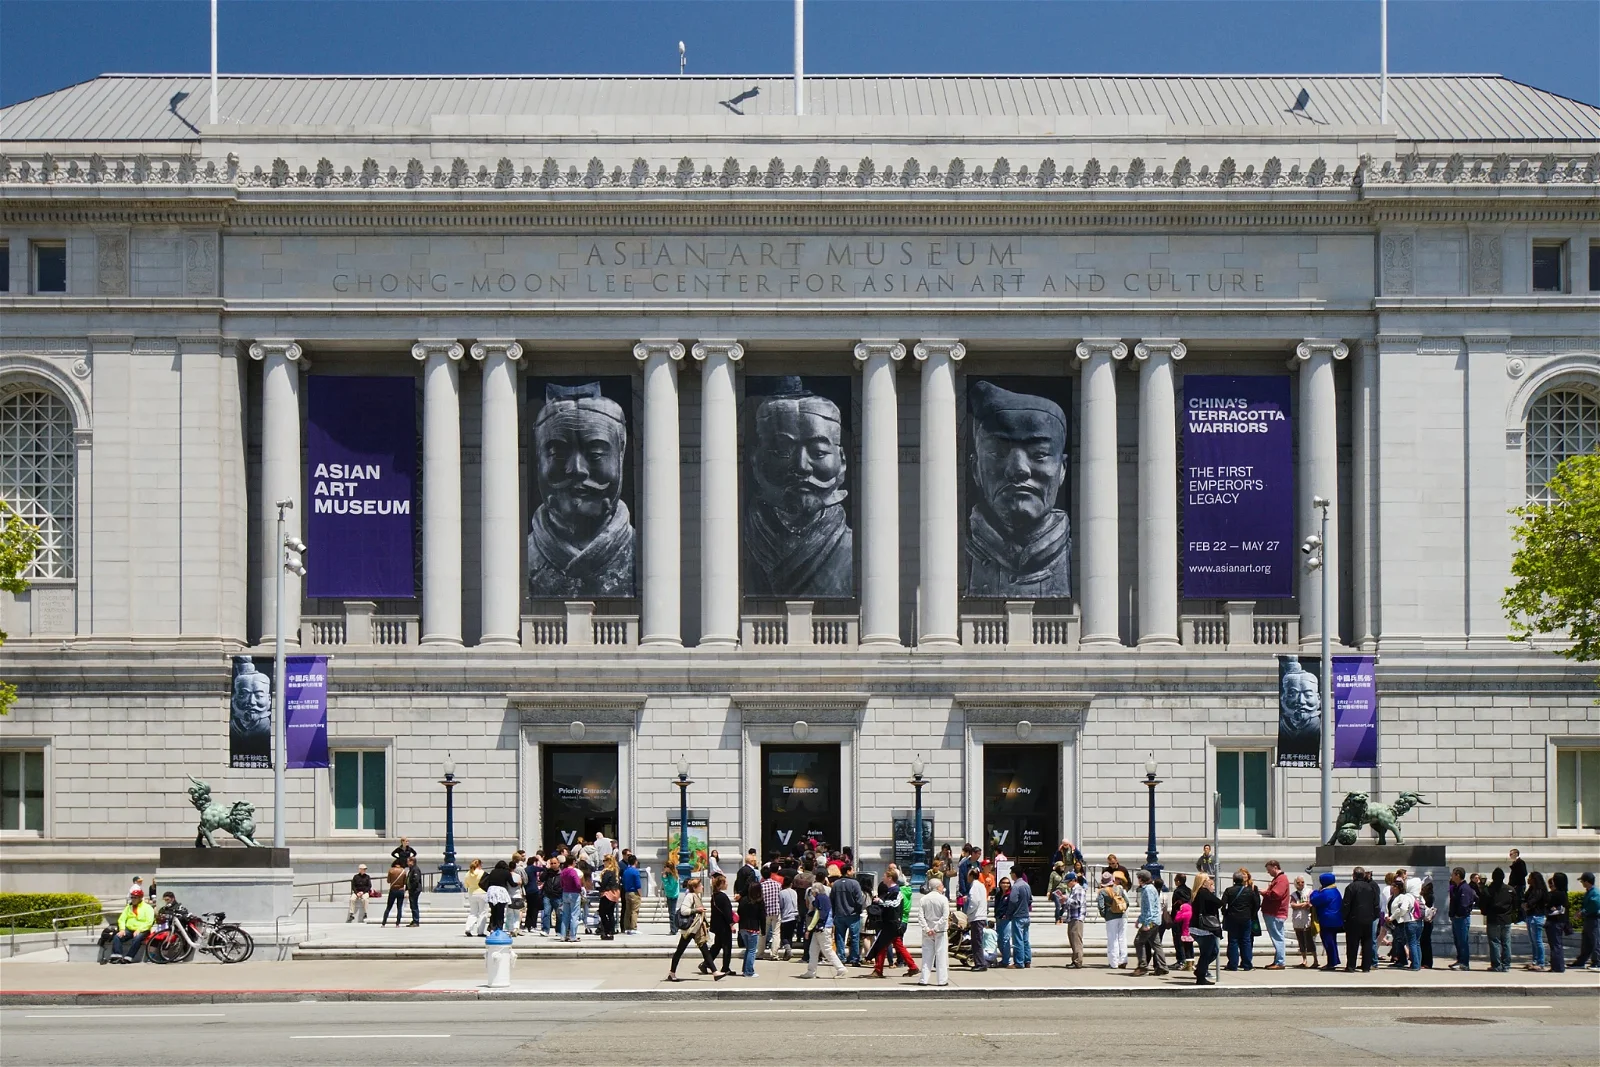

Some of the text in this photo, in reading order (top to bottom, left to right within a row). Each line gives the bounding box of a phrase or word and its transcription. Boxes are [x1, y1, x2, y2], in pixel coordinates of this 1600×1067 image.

[585, 242, 1016, 266] ASIAN ART MUSEUM
[332, 274, 1265, 293] CHONG-MOON LEE CENTER FOR ASIAN ART AND CULTURE
[1189, 398, 1248, 408] CHINA'S
[1189, 410, 1285, 420] TERRACOTTA
[1189, 422, 1268, 433] WARRIORS
[314, 463, 380, 480] ASIAN
[1189, 466, 1253, 478] THE FIRST
[314, 481, 358, 496] ART
[1190, 480, 1263, 491] EMPEROR'S
[1190, 493, 1240, 505] LEGACY
[314, 499, 410, 514] MUSEUM
[1190, 542, 1210, 551] FEB
[1213, 542, 1227, 551] 22
[1242, 542, 1264, 551] MAY
[1267, 541, 1280, 550] 27
[1189, 564, 1271, 574] www.asianart.org
